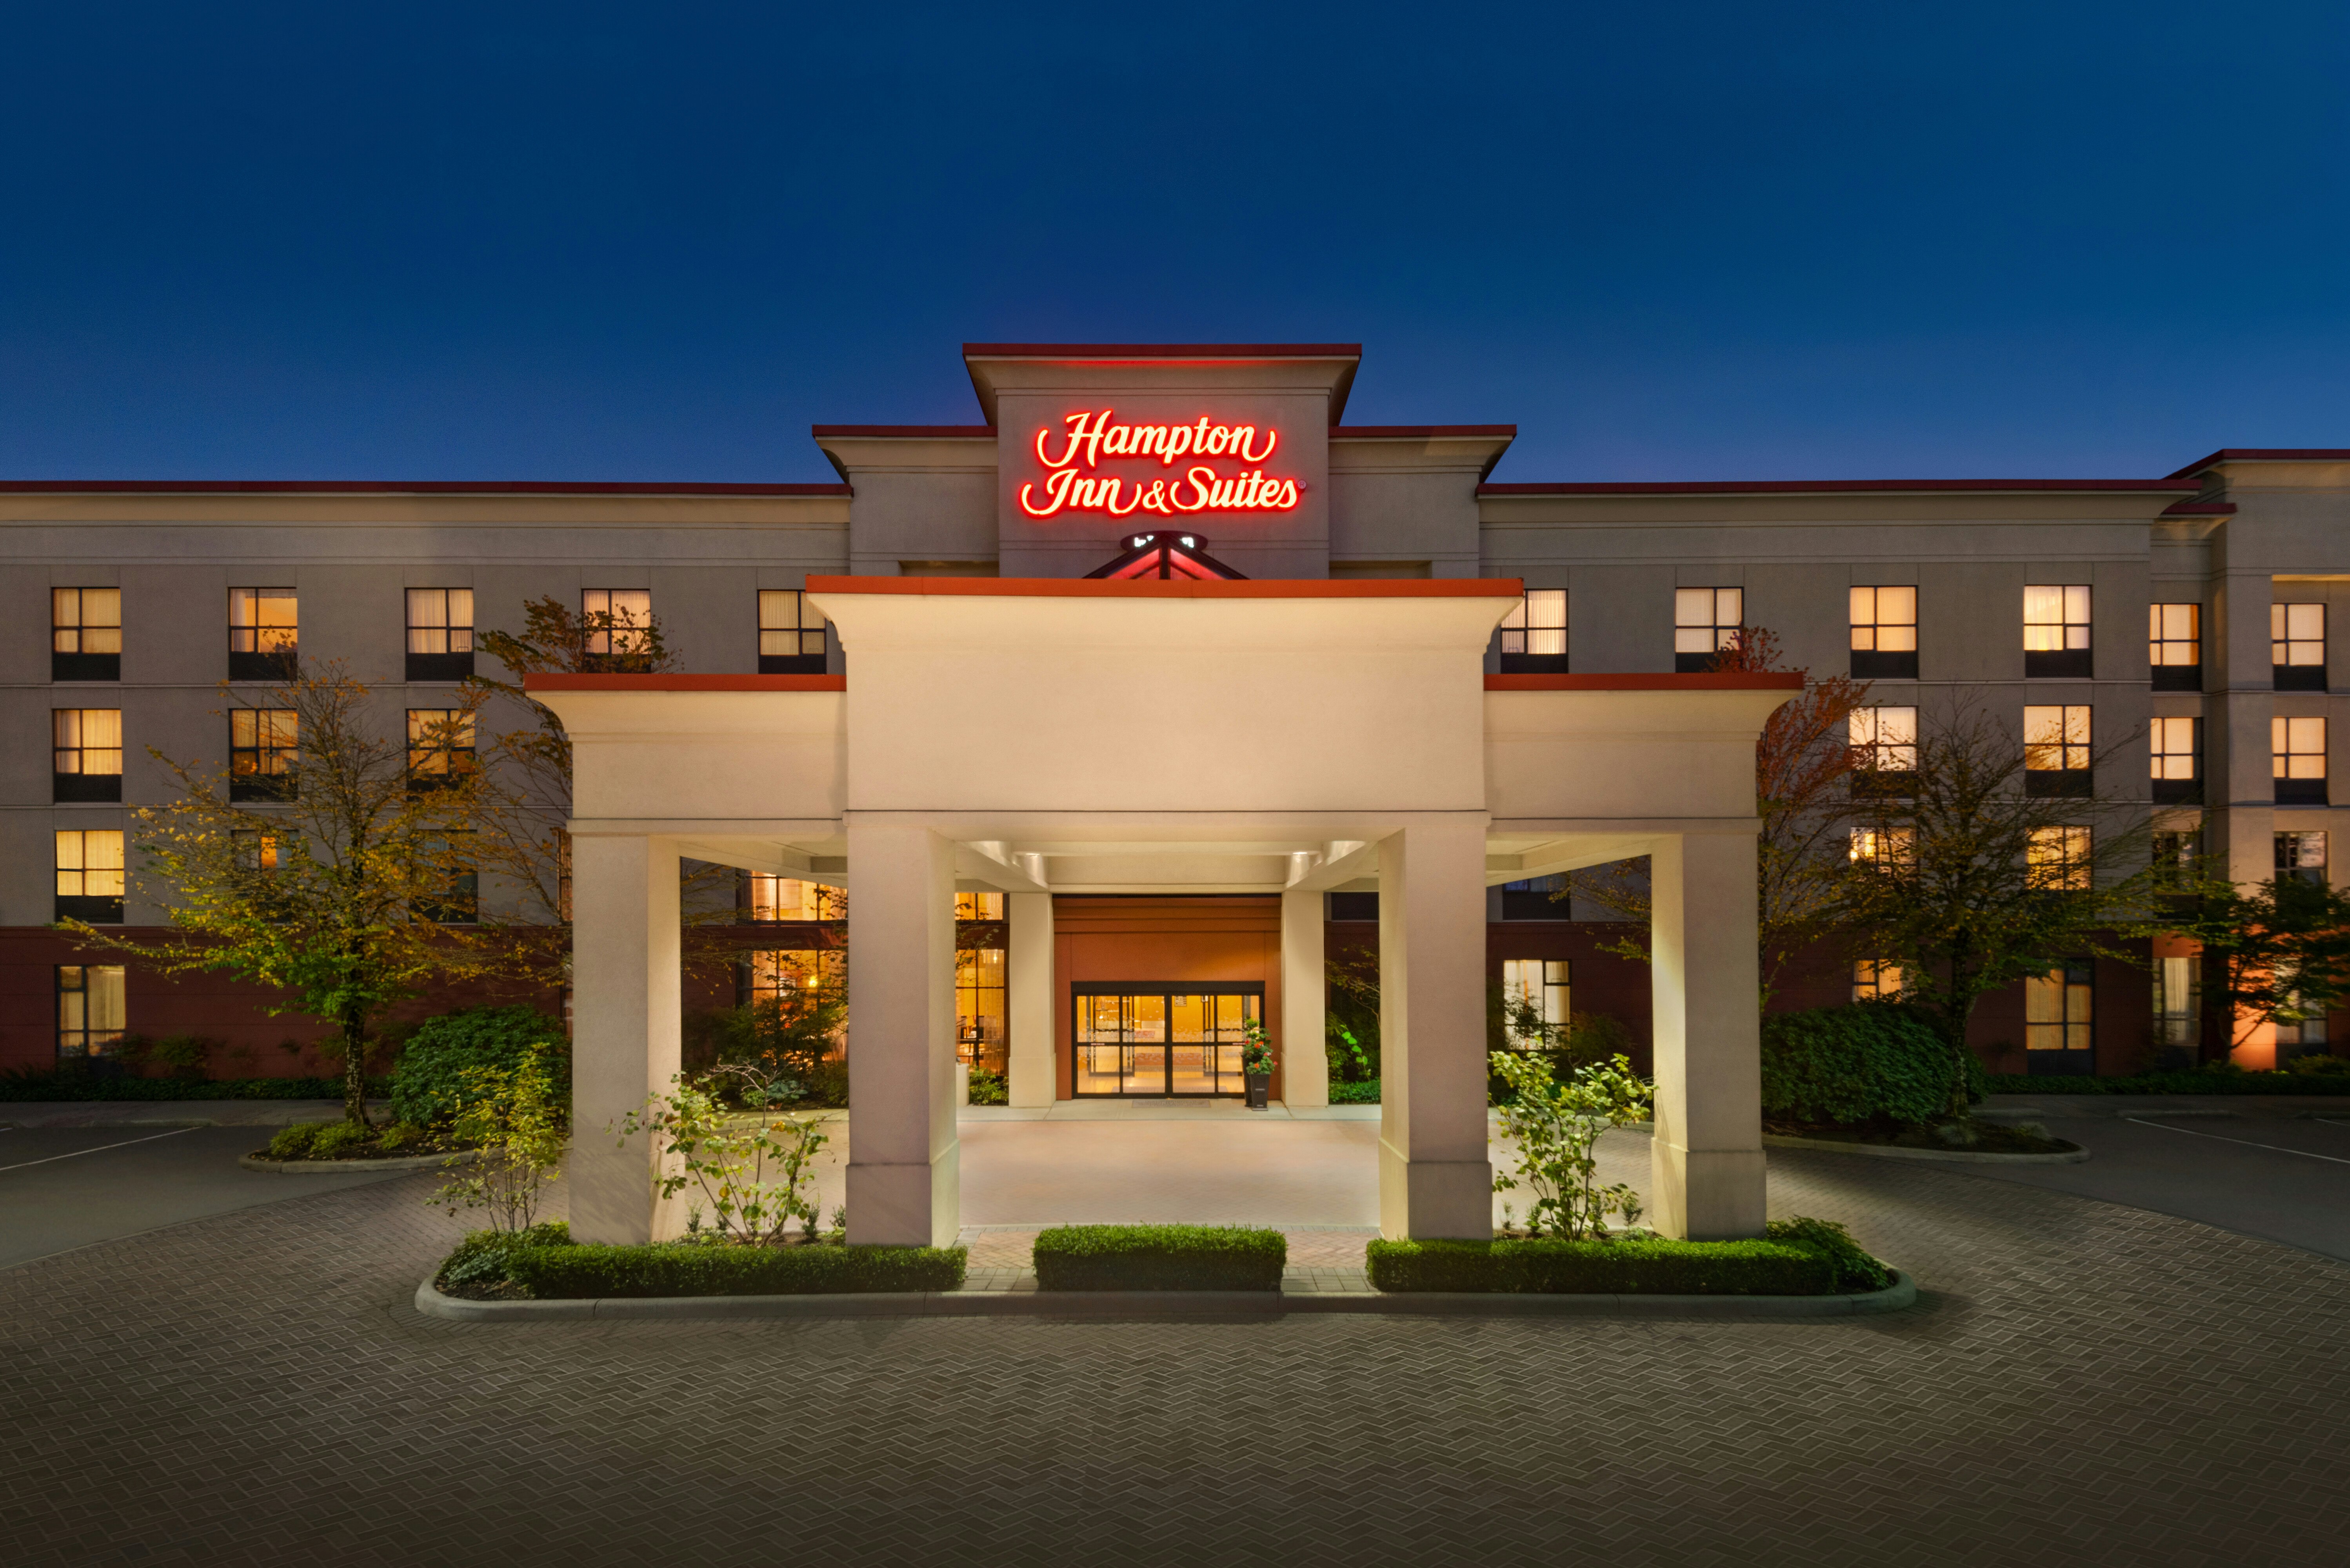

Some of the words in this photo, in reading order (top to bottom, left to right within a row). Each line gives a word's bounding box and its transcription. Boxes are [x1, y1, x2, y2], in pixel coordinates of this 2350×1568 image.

[1036, 410, 1276, 467] Hampton
[1021, 468, 1142, 515] Inn
[1142, 480, 1172, 514] &
[1169, 466, 1297, 510] Suites
